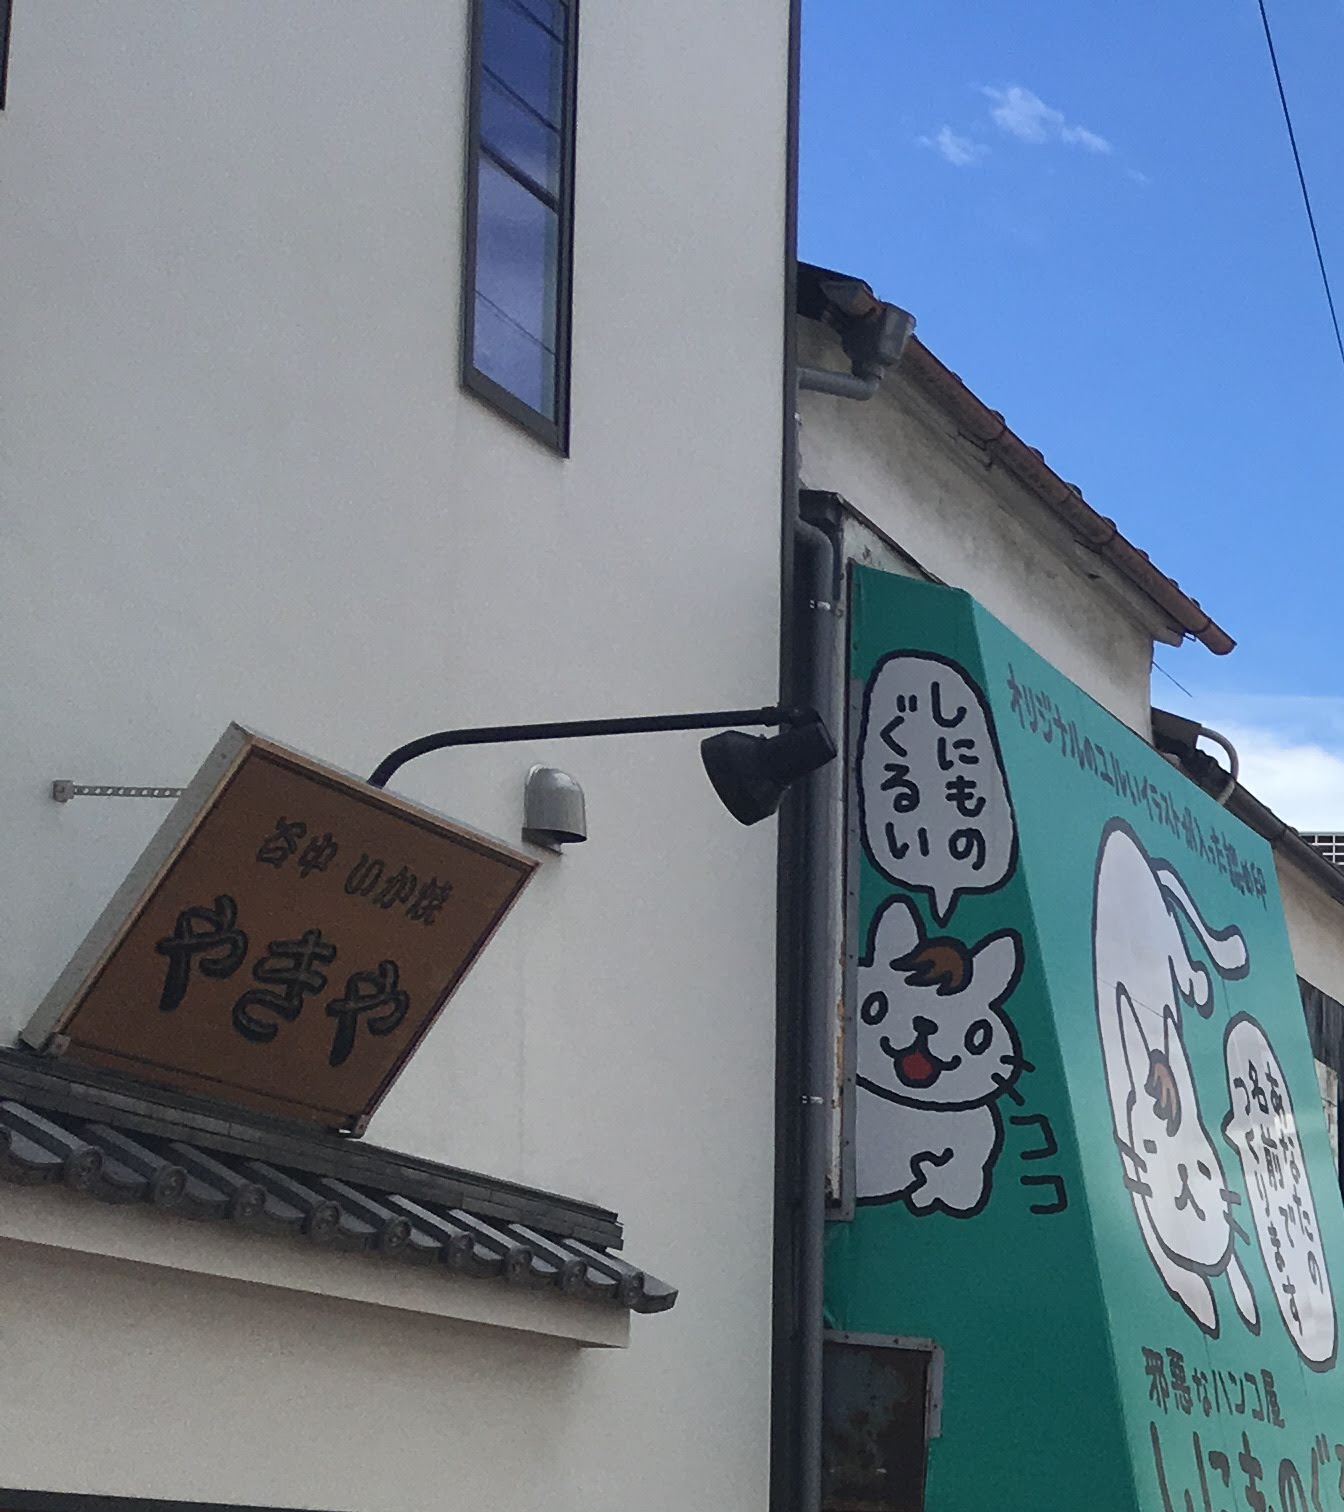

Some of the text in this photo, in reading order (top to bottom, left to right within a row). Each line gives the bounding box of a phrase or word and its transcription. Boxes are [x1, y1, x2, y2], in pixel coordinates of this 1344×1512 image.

[879, 693, 929, 858] ぐるい
[930, 680, 988, 870] しにもの
[255, 813, 452, 926] 谷中 いか焼
[156, 893, 410, 1068] やきや
[1010, 1115, 1068, 1213] ココ
[1233, 1076, 1304, 1336] つくります
[1264, 1060, 1325, 1295] あなたの
[1140, 1345, 1285, 1428] 邪悪なハンコ屋
